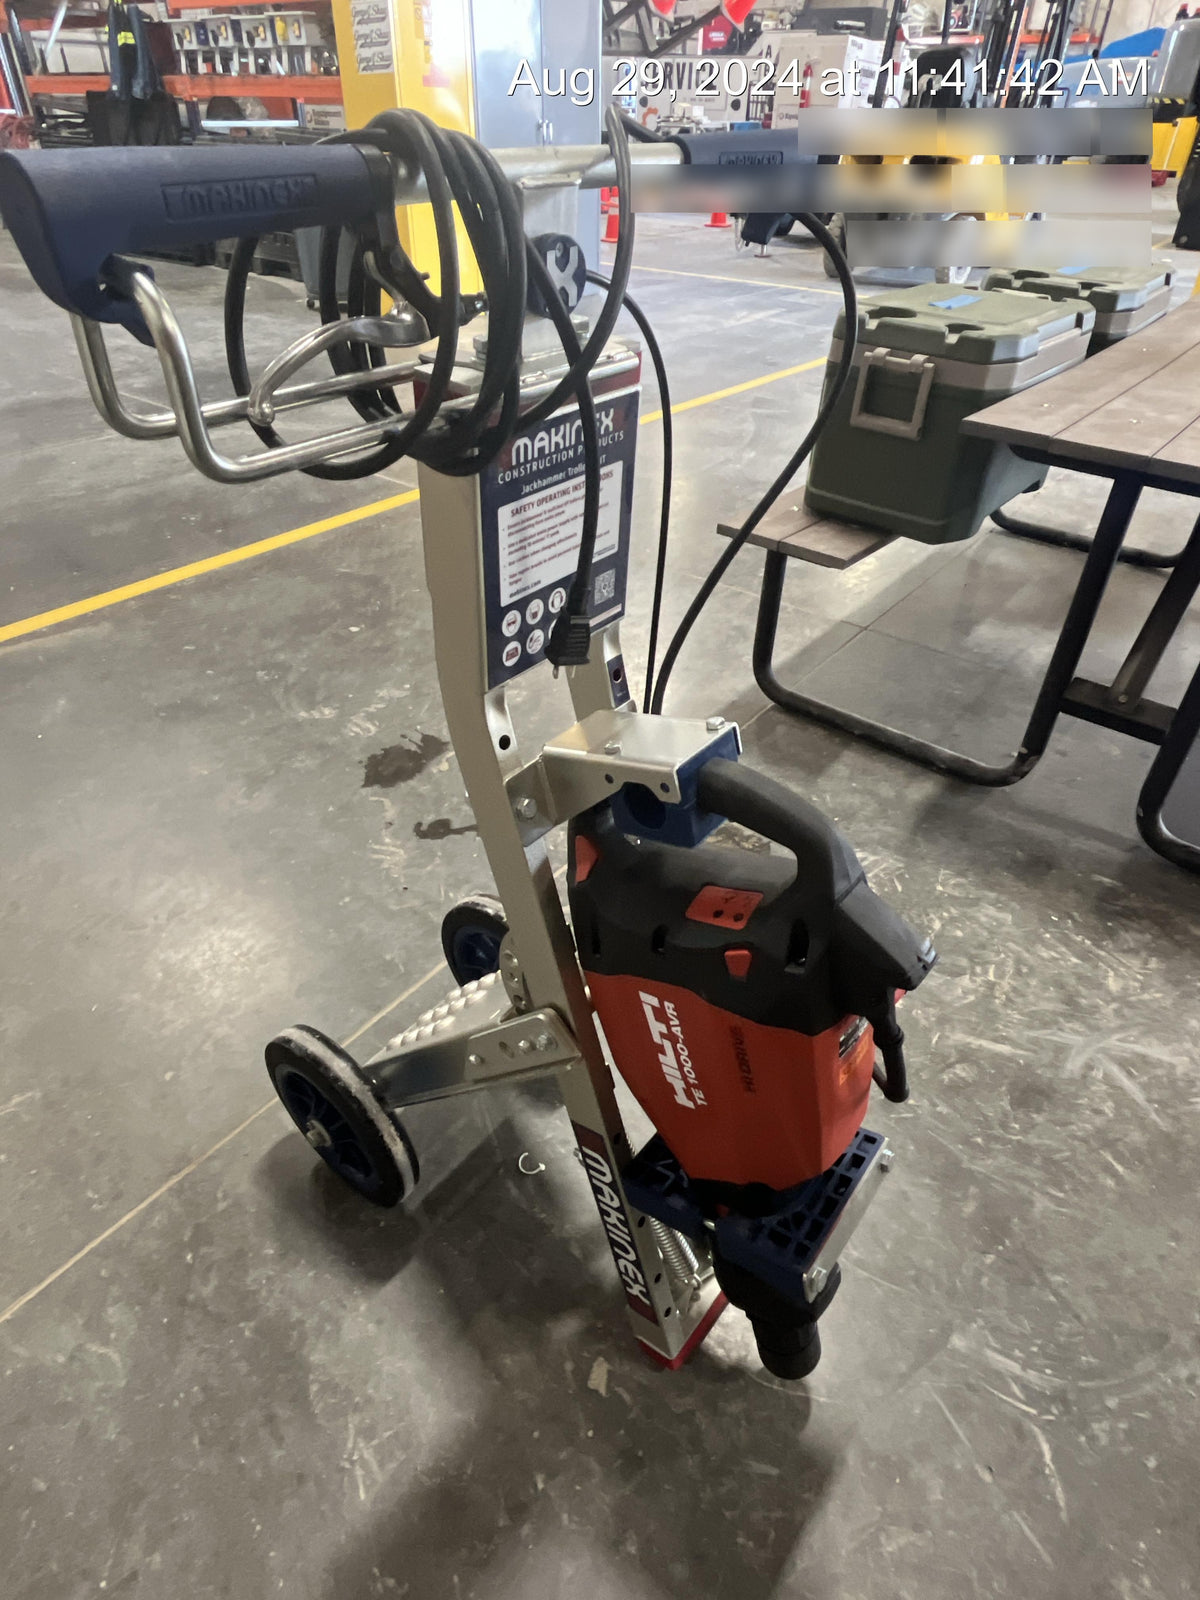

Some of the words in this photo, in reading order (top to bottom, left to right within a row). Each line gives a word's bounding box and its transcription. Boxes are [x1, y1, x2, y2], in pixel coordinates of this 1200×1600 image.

[498, 446, 574, 485] CONSTRUCTION
[577, 430, 624, 456] PUCTS
[511, 407, 614, 466] MAKINX
[511, 502, 535, 518] SAFETY
[536, 487, 571, 508] OPERATING
[571, 469, 614, 493] INSTONS
[521, 471, 566, 495] Jackhammer
[638, 990, 696, 1110] HILTI
[663, 1000, 698, 1085] 1000-AVR
[691, 1087, 708, 1106] TE
[581, 1145, 650, 1307] MAKINEX
